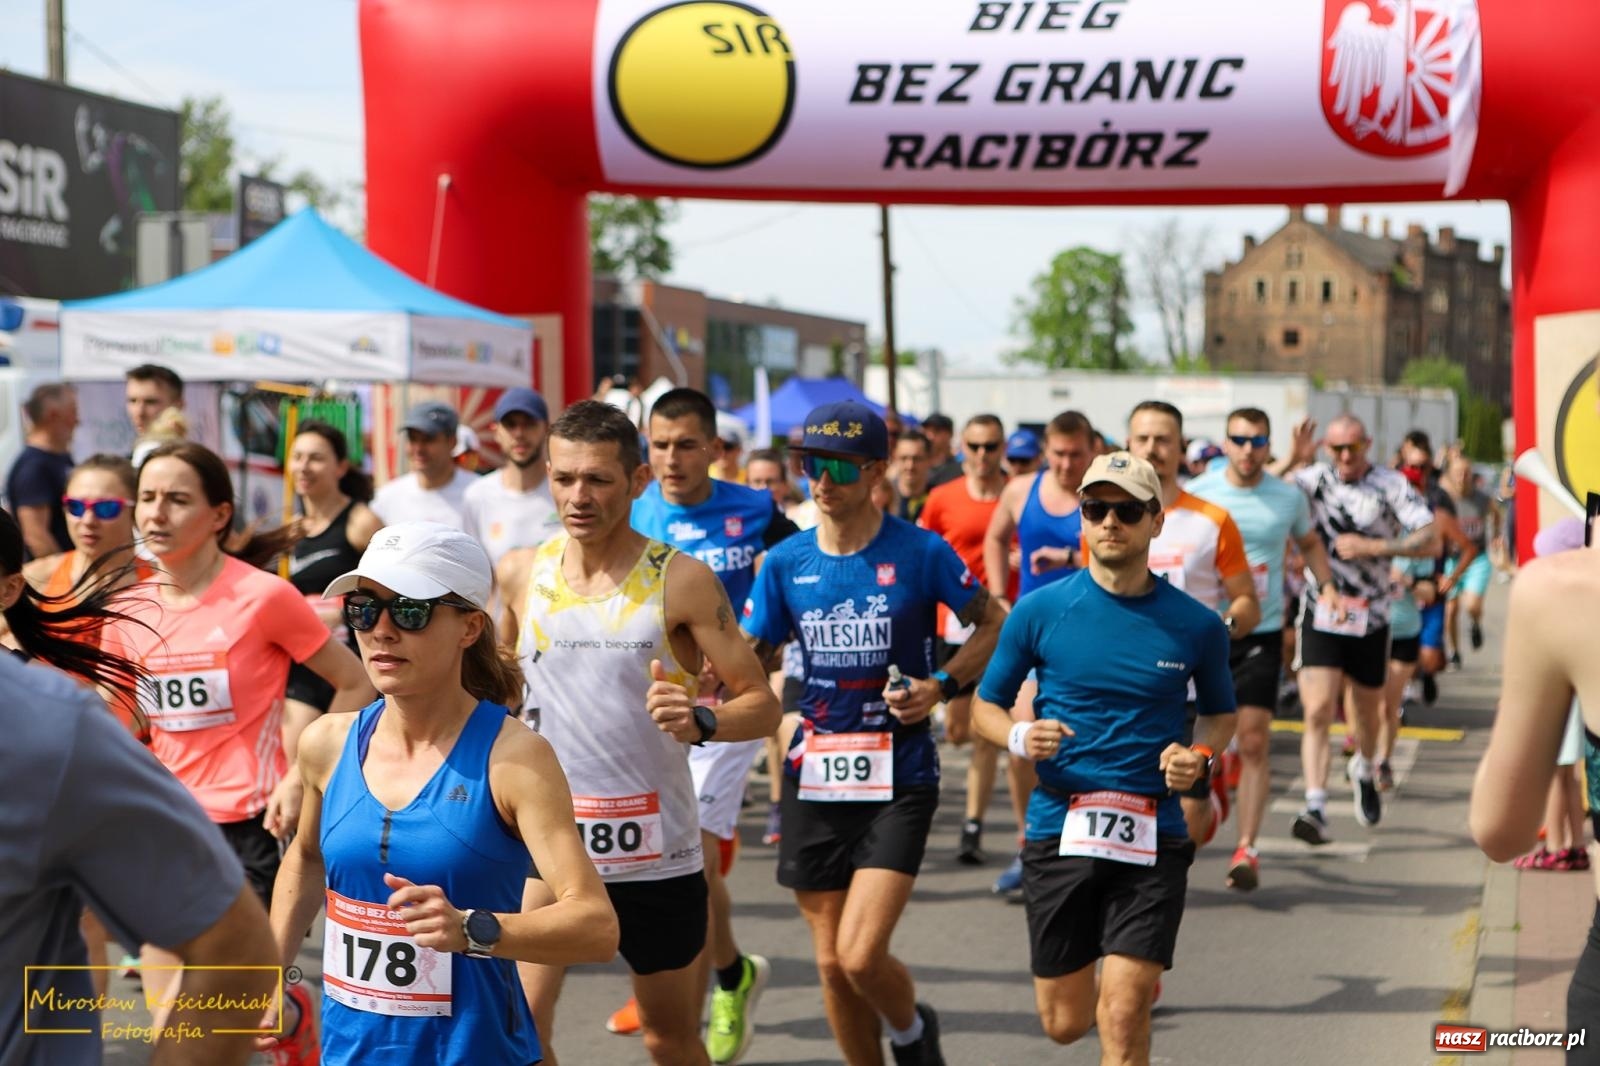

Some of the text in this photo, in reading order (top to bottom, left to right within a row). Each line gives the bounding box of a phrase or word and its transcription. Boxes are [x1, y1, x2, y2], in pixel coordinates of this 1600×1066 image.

[969, 1, 1128, 32] BIEG
[849, 58, 1244, 104] BEZ GRANIC
[882, 121, 1211, 171] RACIBÓRZ
[605, 638, 654, 651] biegania
[804, 621, 889, 648] SILESIAN
[823, 756, 871, 782] 199
[1086, 811, 1135, 843] 173
[366, 907, 387, 919] BEZ
[343, 932, 417, 987] 178
